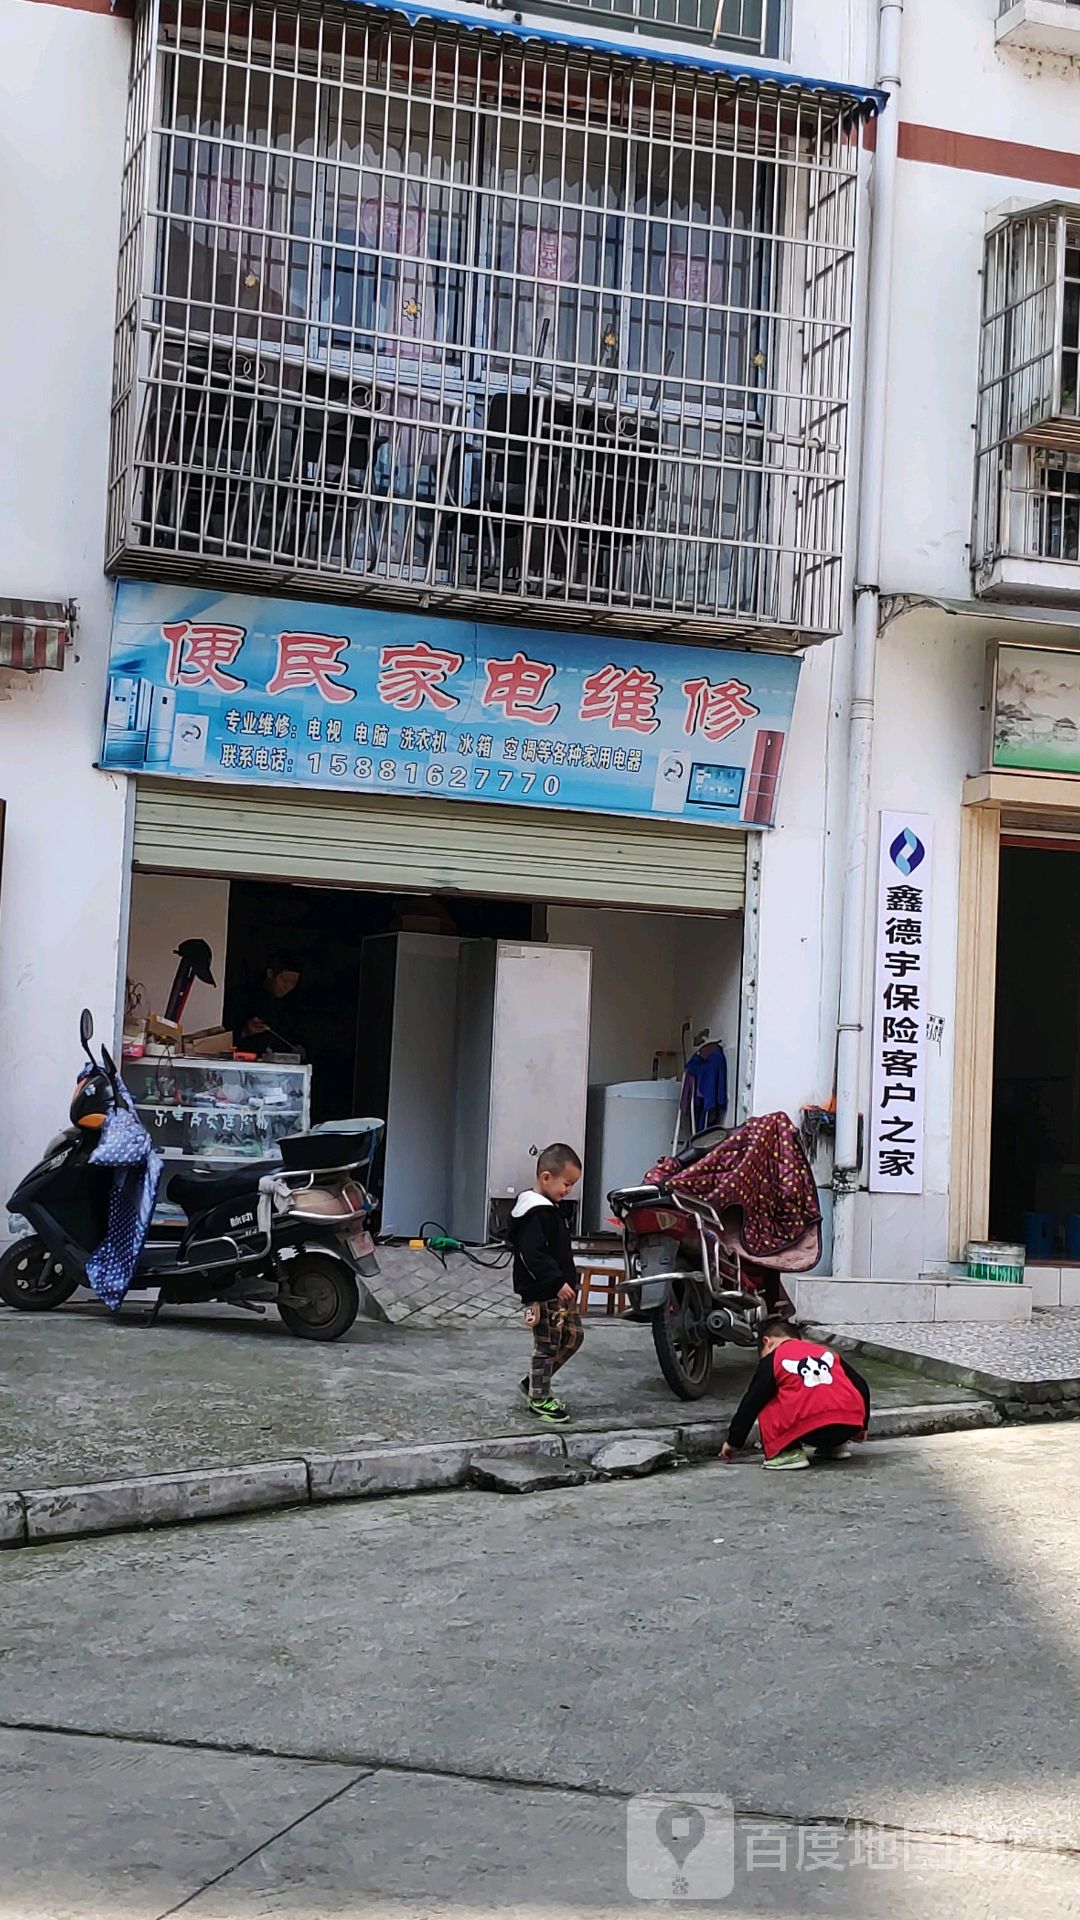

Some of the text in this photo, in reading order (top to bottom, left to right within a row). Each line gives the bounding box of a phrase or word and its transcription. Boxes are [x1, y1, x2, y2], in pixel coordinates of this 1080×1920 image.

[161, 621, 760, 742] 便民家电维修
[307, 717, 343, 743] 电视
[354, 722, 390, 747] 电脑
[400, 726, 447, 753] 洗衣机
[458, 732, 493, 758] 冰箱
[502, 736, 643, 772] 空调等各种家用电器
[307, 752, 561, 796] 15881627770
[878, 884, 924, 1178] 鑫德宇保险客户之家
